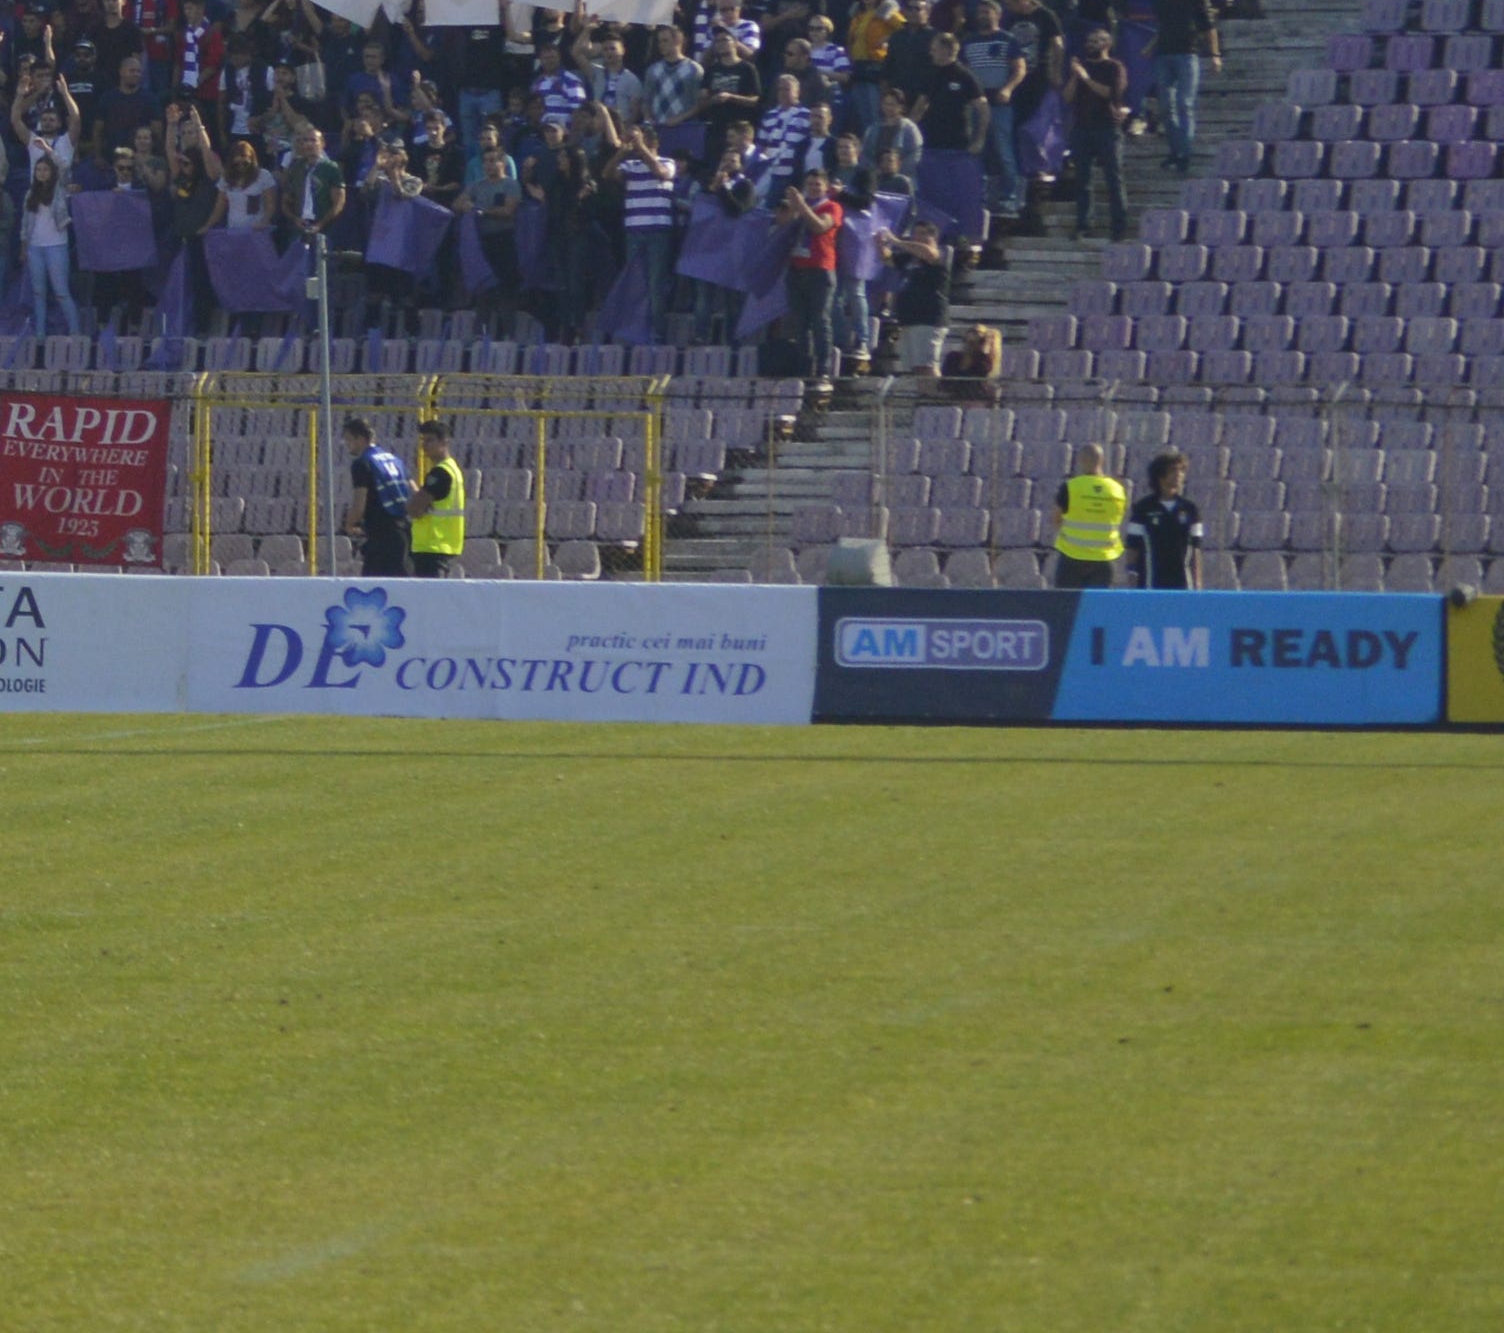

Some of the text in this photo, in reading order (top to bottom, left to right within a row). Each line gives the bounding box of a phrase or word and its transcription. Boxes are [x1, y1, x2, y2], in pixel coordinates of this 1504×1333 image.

[2, 402, 157, 445] RAPID
[3, 441, 149, 466] EVERYWHERE
[39, 467, 119, 486] IN THE
[14, 484, 144, 518] WORLD
[57, 517, 99, 537] 1923
[566, 631, 766, 653] practic cei mai buni
[849, 627, 1037, 662] AM SPORT
[1091, 626, 1419, 670] I AM READY
[396, 655, 672, 694] CONSTRUCT
[681, 661, 766, 697] IND
